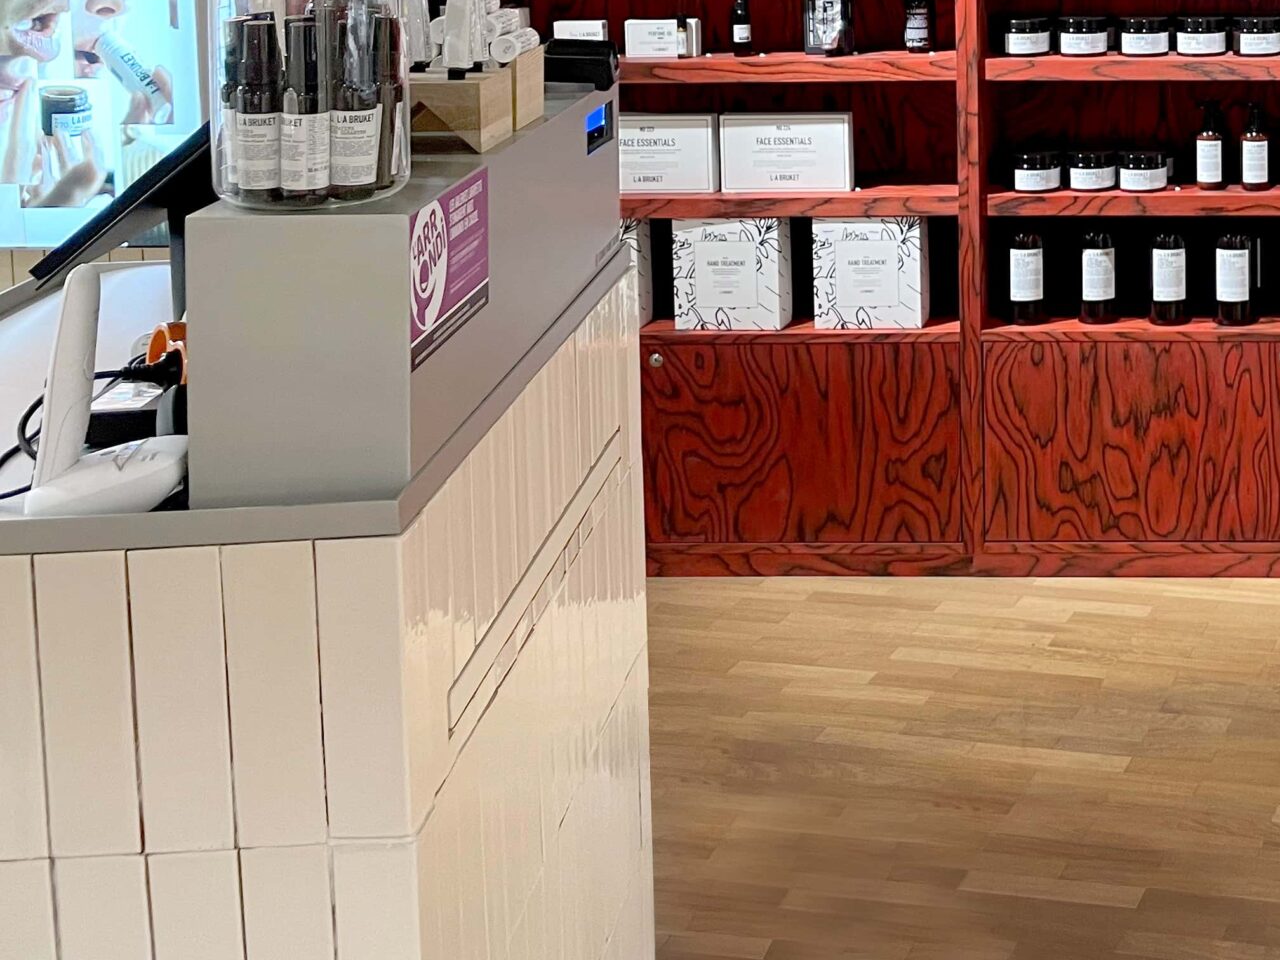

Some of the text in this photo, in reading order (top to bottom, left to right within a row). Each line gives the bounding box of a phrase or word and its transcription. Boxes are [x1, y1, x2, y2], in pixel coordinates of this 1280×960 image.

[120, 52, 151, 82] BRUKET
[248, 117, 276, 127] BRUKET
[348, 113, 374, 124] BRUKET
[619, 138, 676, 147] FACE ESSENTIALS
[756, 137, 812, 145] FACE ESSENTIALS
